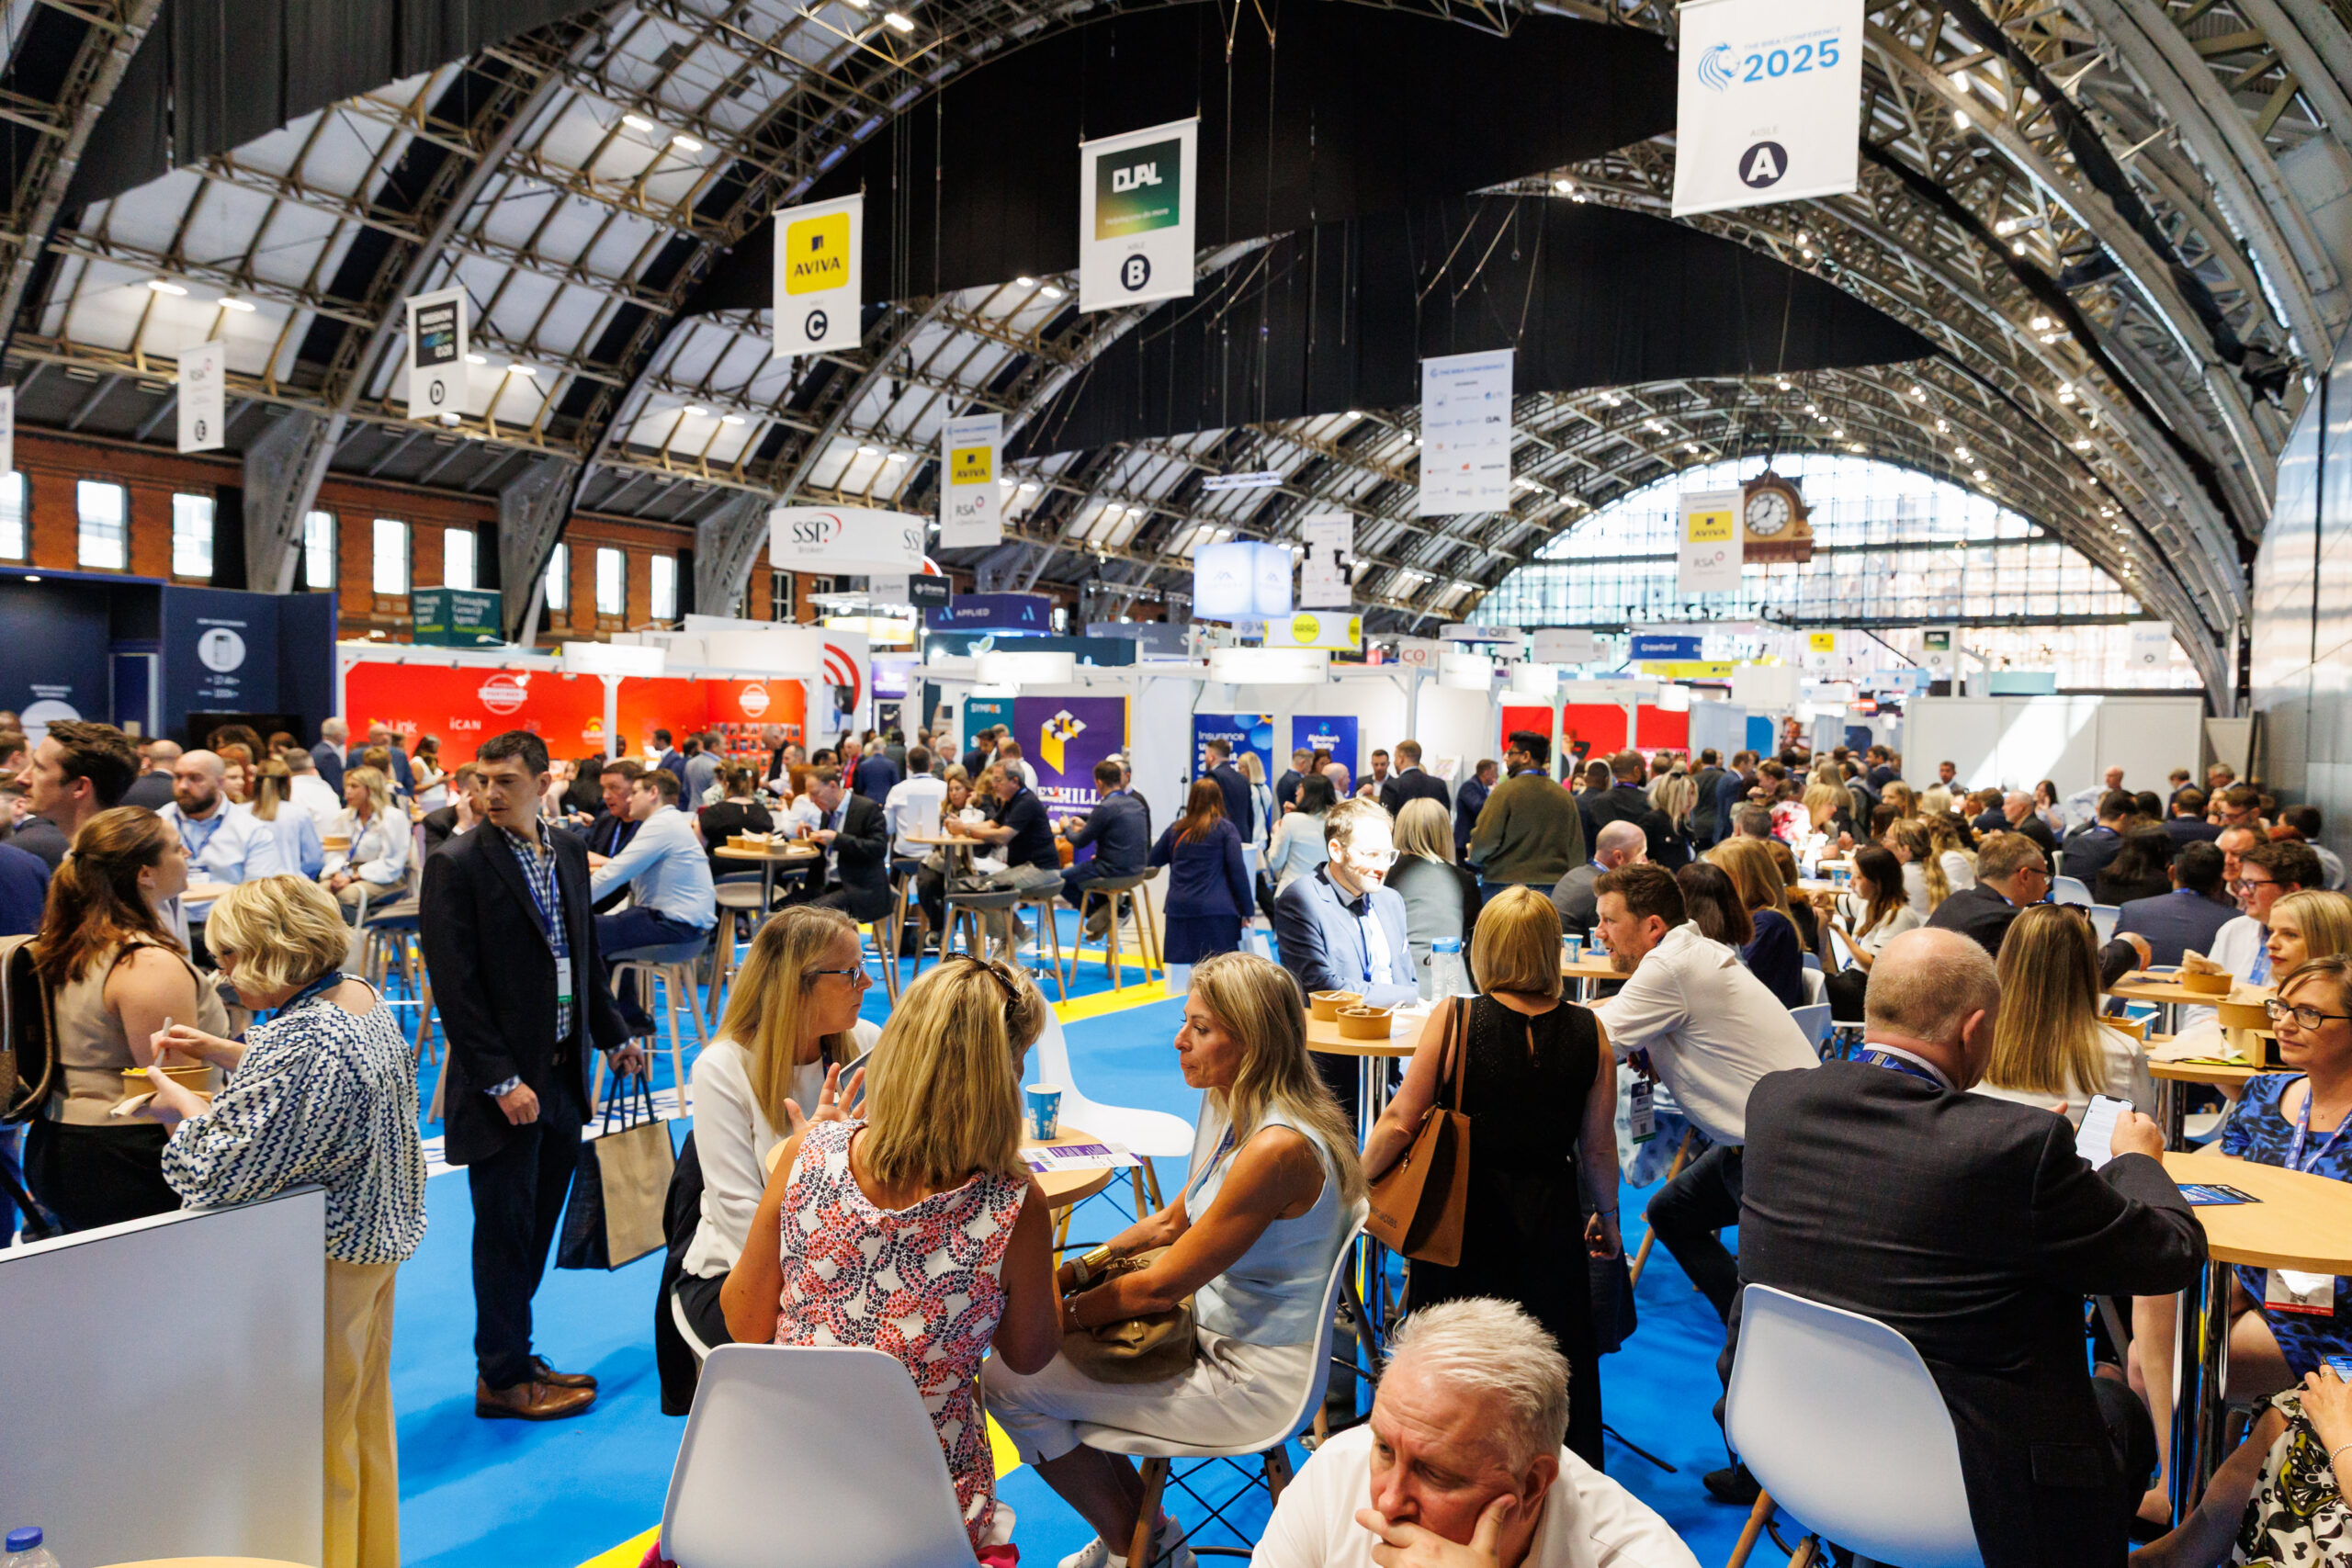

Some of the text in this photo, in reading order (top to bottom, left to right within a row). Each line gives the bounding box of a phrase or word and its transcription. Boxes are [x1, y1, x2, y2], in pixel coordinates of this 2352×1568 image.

[1783, 26, 1841, 43] CONFERENCE
[1743, 38, 1839, 84] 2025
[1749, 125, 1780, 138] AISLE
[1746, 146, 1780, 183] A
[1113, 162, 1163, 194] DUAL
[794, 256, 841, 277] AVIVA
[1126, 258, 1146, 288] B
[808, 313, 826, 338] C
[956, 468, 987, 479] AVIVA
[956, 504, 976, 516] RSA
[903, 528, 922, 552] SS
[1694, 528, 1727, 537] AVIVA
[1693, 558, 1715, 569] RSA
[956, 607, 990, 618] APPLIED
[449, 716, 481, 731] iCAN
[1198, 731, 1245, 742] Insurance
